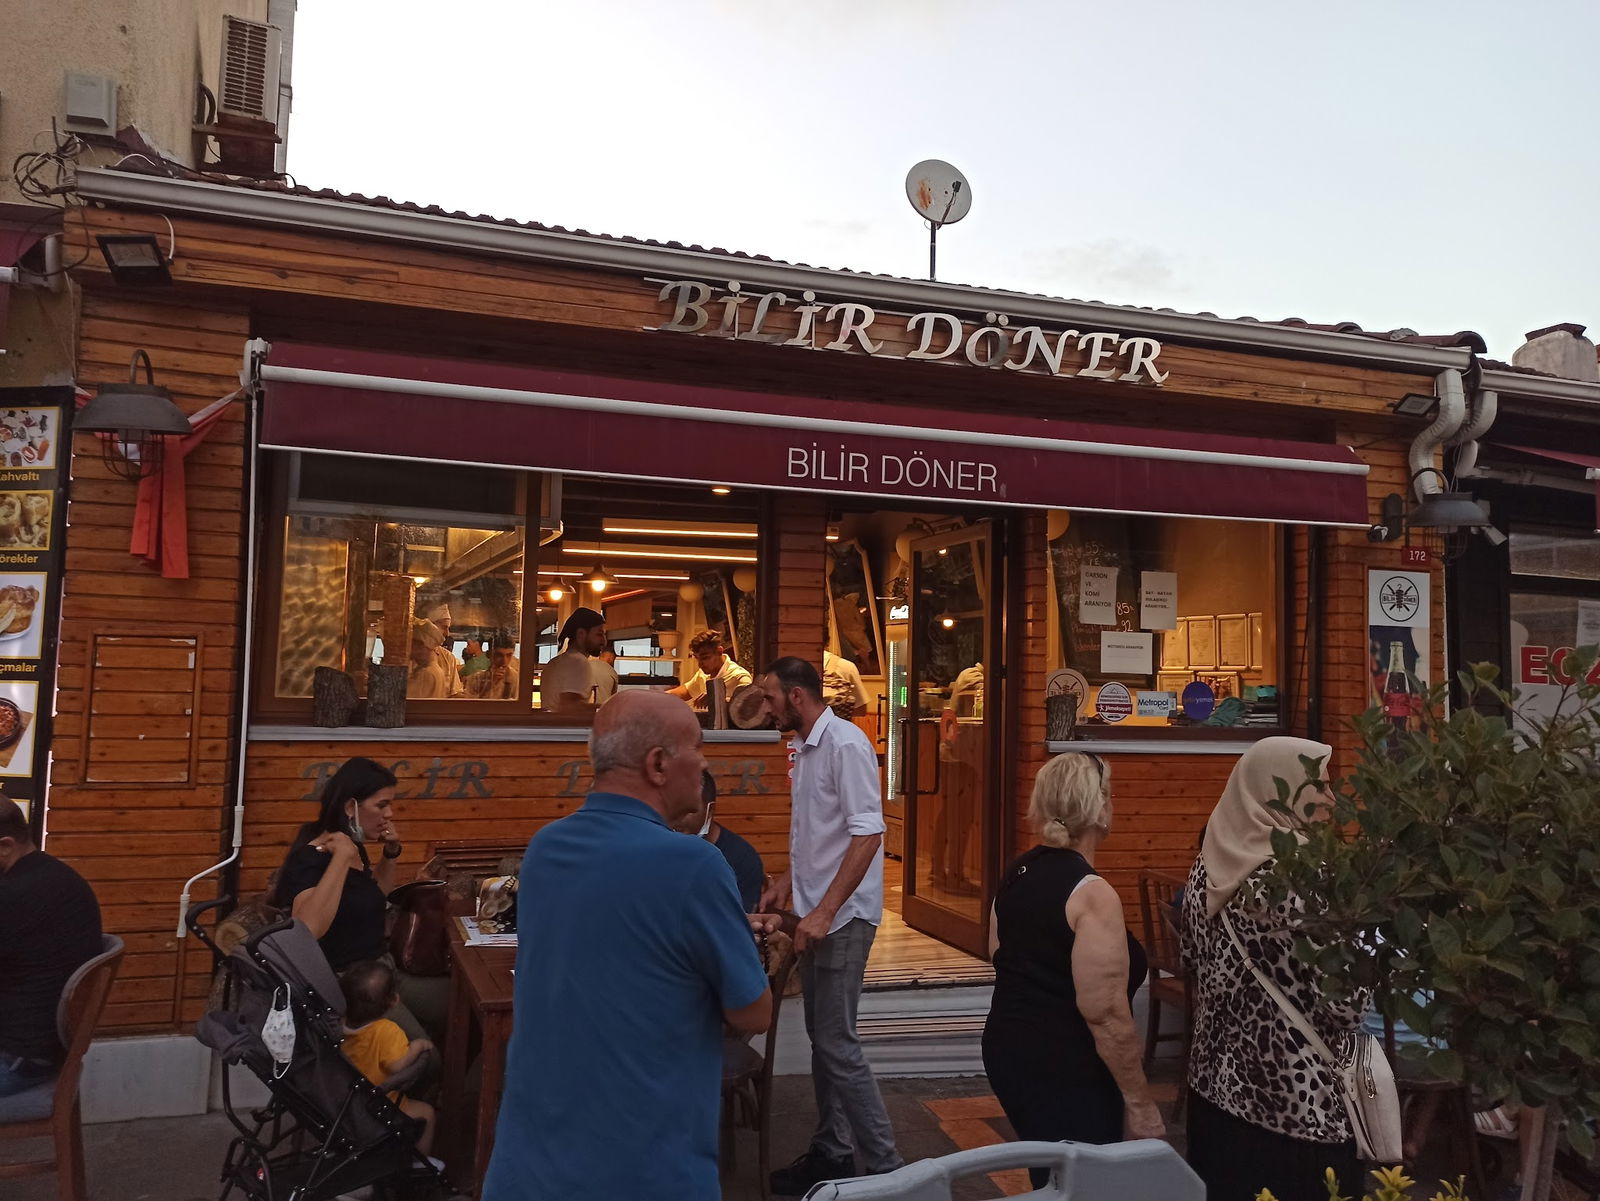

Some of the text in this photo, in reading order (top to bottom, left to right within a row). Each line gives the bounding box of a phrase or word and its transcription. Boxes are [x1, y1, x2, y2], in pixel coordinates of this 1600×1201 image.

[657, 280, 1170, 386] BİLİR DÖNER
[787, 442, 998, 493] BİLİR DÖNER
[0, 471, 39, 481] ahvaltı
[1409, 550, 1426, 561] 172
[1137, 698, 1169, 707] Metropol
